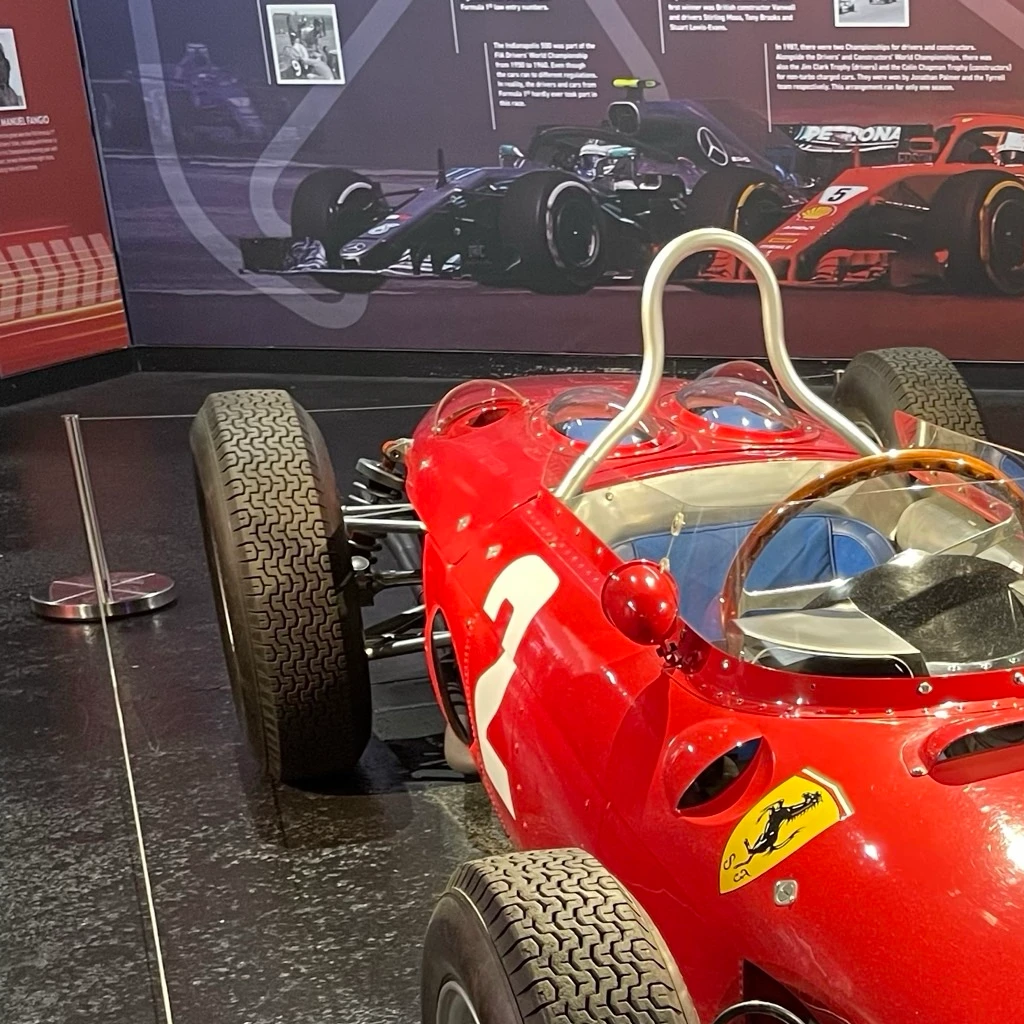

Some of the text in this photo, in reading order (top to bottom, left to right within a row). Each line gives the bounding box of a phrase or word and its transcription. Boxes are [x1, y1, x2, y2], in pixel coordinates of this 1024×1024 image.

[26, 115, 50, 125] FANGIO
[827, 188, 852, 202] 5
[474, 554, 560, 821] 2
